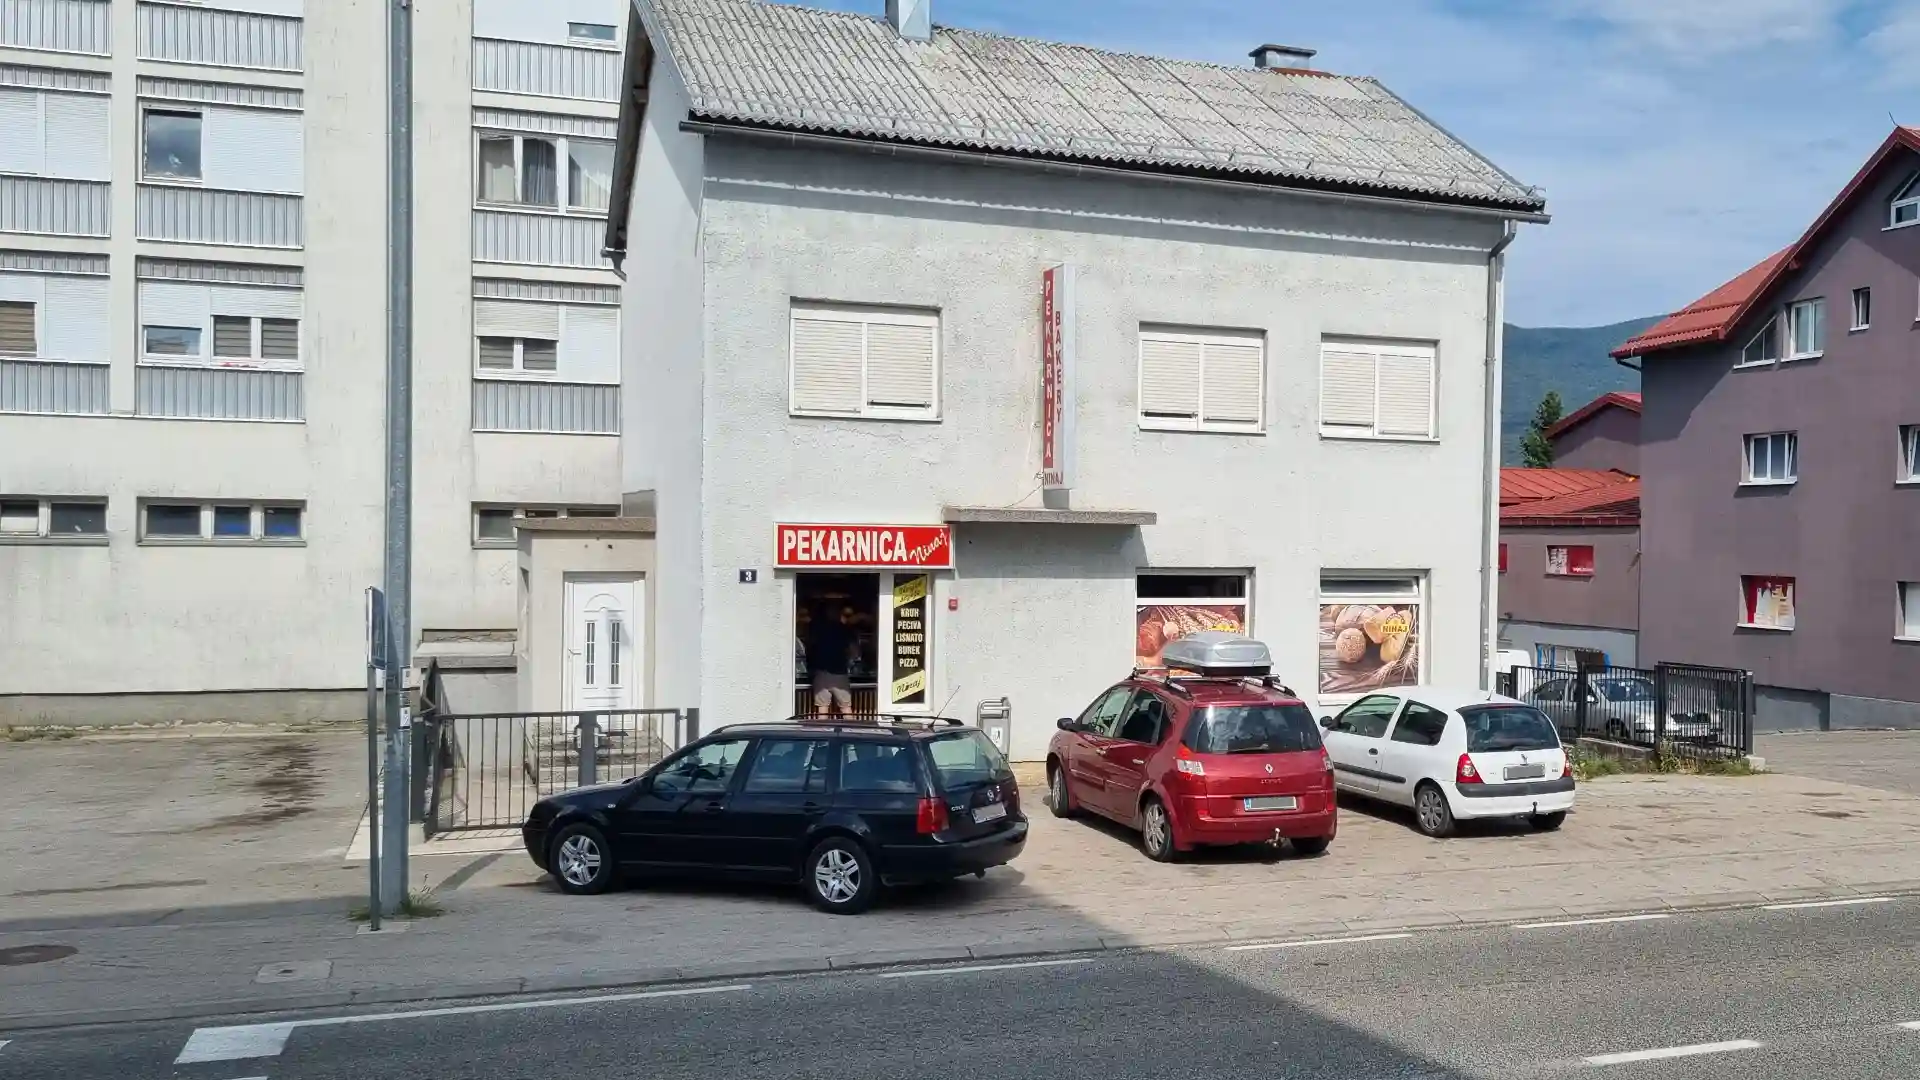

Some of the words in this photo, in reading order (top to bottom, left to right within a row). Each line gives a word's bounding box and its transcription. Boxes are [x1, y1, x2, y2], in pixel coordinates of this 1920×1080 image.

[1044, 280, 1053, 459] PEKARNICA
[1054, 310, 1063, 424] BAKERY
[1043, 469, 1064, 486] NINAJ
[783, 529, 908, 562] PEKARNICA
[909, 528, 948, 564] Ninaj
[745, 571, 752, 582] 3
[900, 608, 920, 618] KRUH
[897, 620, 922, 630] PECIVA
[895, 633, 924, 643] LISNATO
[898, 645, 920, 655] BUREK
[899, 658, 919, 668] PIZZA
